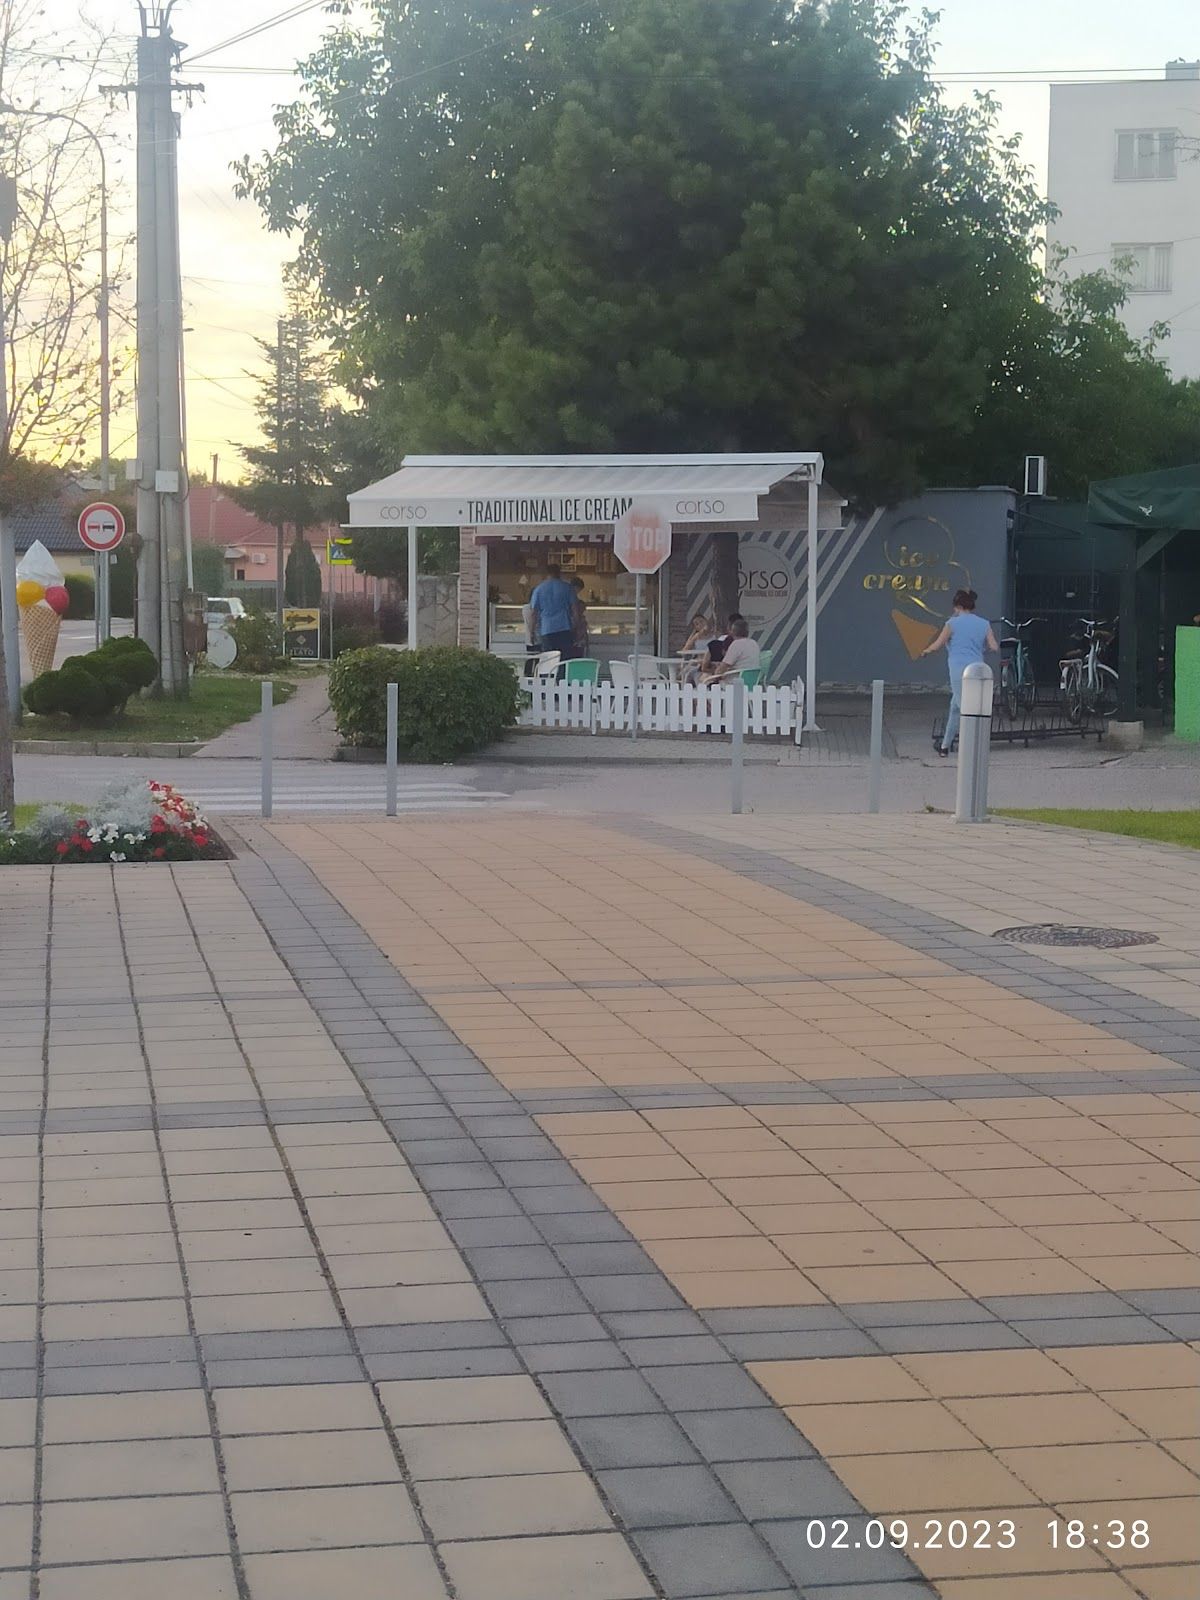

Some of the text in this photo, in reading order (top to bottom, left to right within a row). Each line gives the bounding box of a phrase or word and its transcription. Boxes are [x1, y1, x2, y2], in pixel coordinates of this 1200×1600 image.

[380, 505, 427, 520] corso
[467, 497, 633, 523] TRADITIONAL ICE CREAM
[675, 500, 725, 515] corso
[623, 527, 665, 552] STOP
[738, 570, 788, 589] orso
